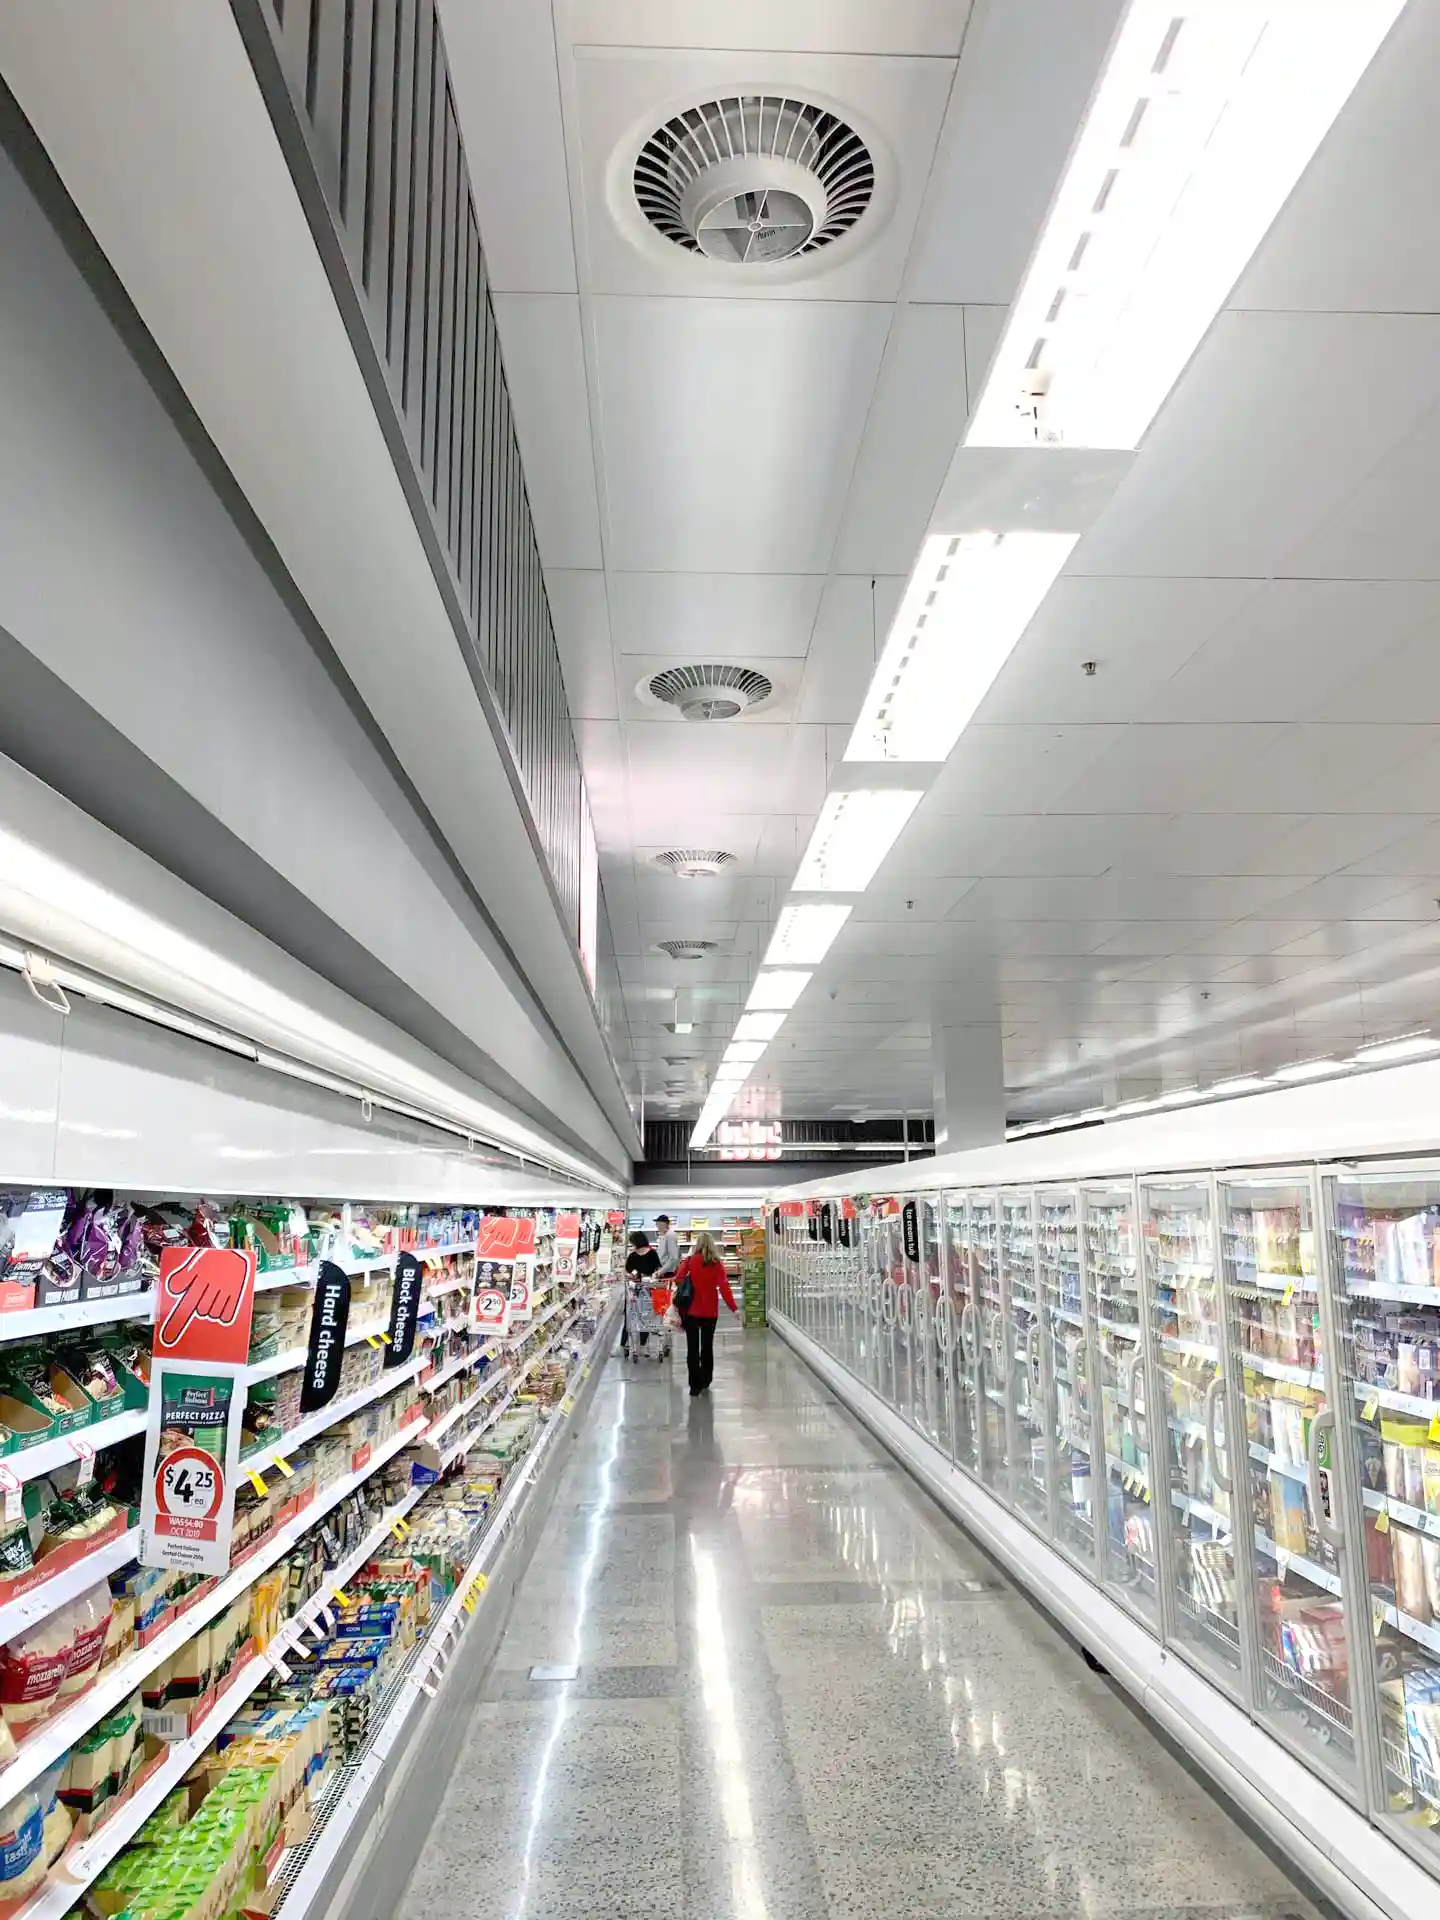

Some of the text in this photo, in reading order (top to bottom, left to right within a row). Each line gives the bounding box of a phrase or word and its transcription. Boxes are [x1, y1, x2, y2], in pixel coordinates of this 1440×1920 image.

[393, 1268, 415, 1352] Block cheese
[313, 1285, 342, 1389] Hard cheese
[165, 1411, 226, 1421] PERFECT PIZZA
[170, 1527, 184, 1536] OCT
